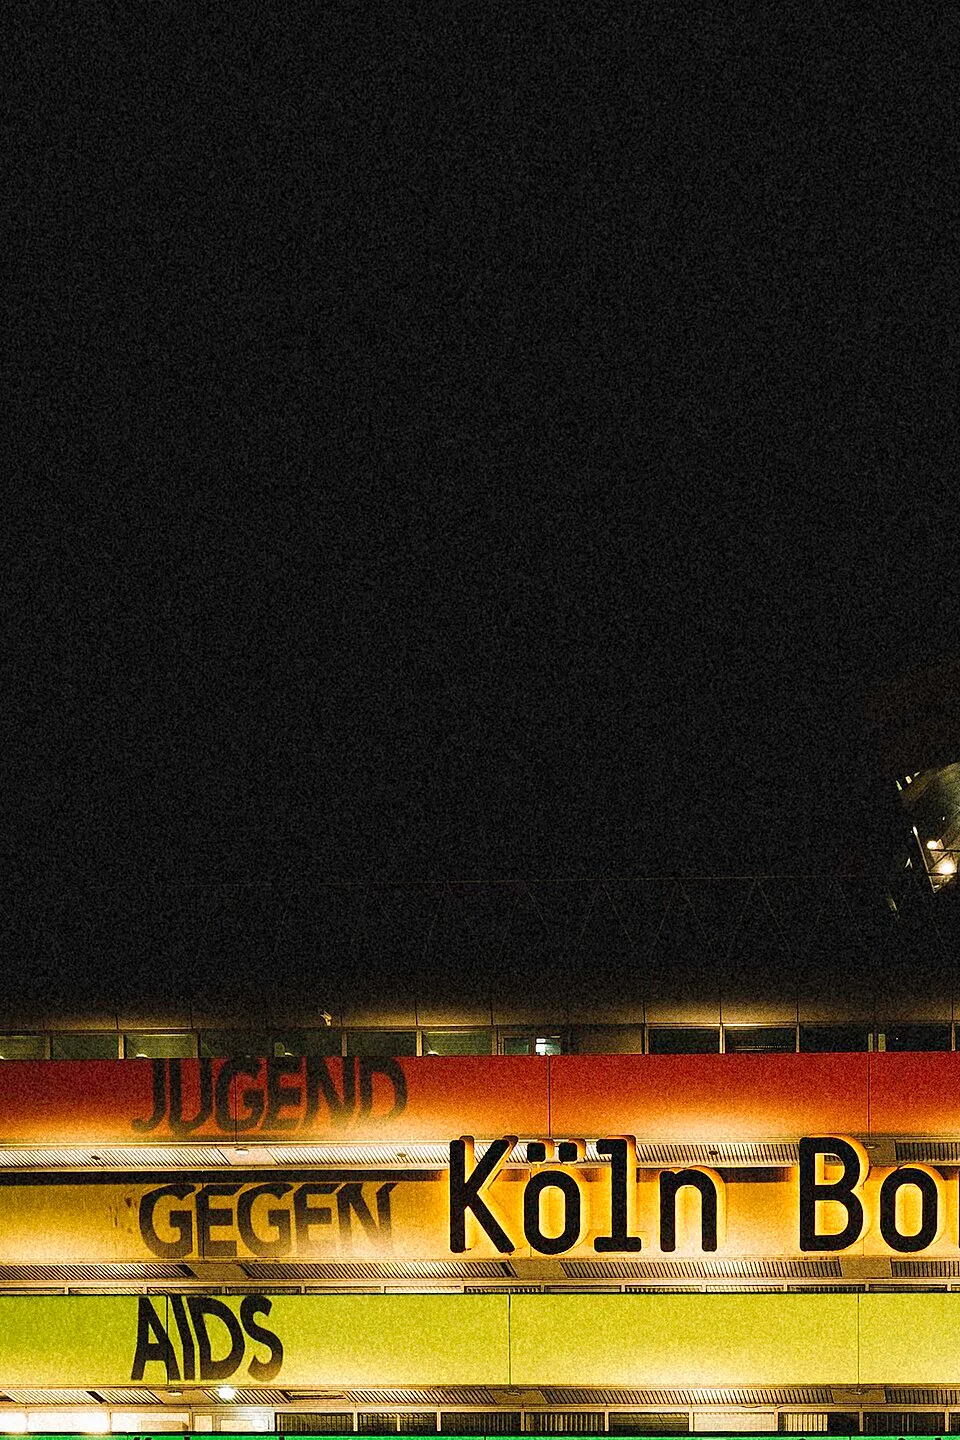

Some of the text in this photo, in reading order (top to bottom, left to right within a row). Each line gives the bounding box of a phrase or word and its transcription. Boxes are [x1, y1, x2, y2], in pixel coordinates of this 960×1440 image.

[132, 1056, 408, 1133] JUGEND
[138, 1183, 398, 1257] GEGEN
[448, 1135, 719, 1255] Köln
[131, 1295, 284, 1382] AIDS
